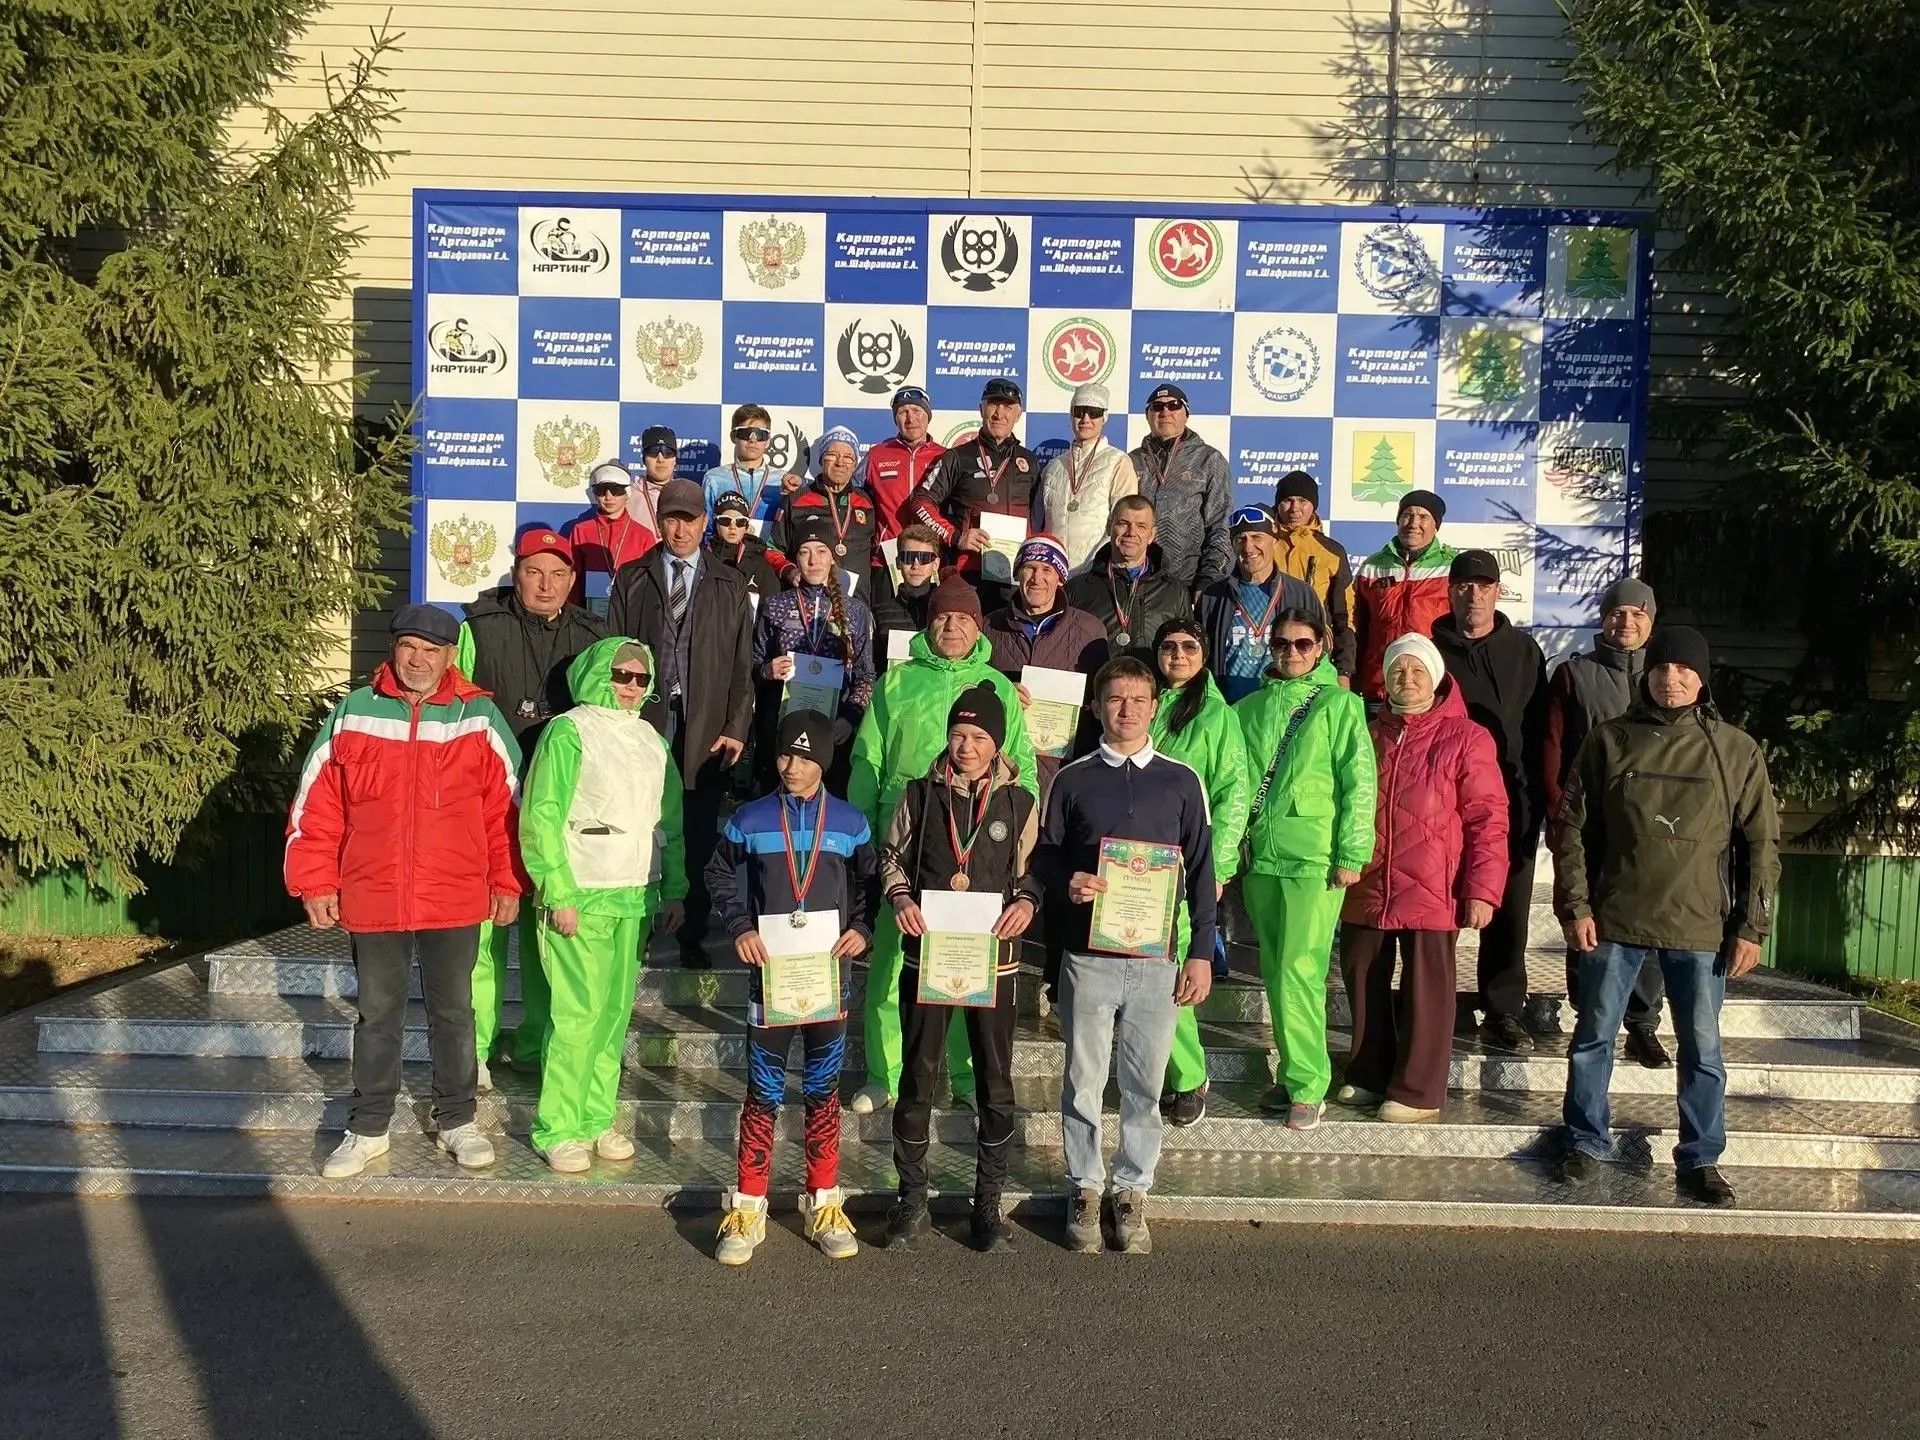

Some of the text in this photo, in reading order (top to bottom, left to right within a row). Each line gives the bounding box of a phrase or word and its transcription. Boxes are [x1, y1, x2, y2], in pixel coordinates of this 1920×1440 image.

[428, 224, 505, 236] Картодром
[631, 228, 710, 240] Картодром
[430, 237, 502, 248] "Аргамак"
[836, 233, 915, 245] Картодром
[1042, 237, 1121, 249] Картодром
[634, 242, 706, 253] "Аргамак"
[839, 246, 912, 258] "Аргамак"
[1248, 241, 1327, 253] Картодром
[629, 256, 696, 266] им.Шафранова
[1045, 250, 1118, 262] "Аргамак"
[1251, 254, 1324, 266] "Аргамак"
[533, 264, 591, 273] КАРТИНГ
[834, 260, 900, 270] им.Шафранова
[1040, 264, 1106, 274] им.Шафранова
[1246, 268, 1312, 279] им.Шафранова
[533, 330, 612, 342] Картодром
[735, 335, 814, 347] Картодром
[536, 343, 609, 354] "Аргамак"
[937, 339, 1016, 351] Картодром
[1142, 344, 1221, 356] Картодром
[738, 348, 810, 360] "Аргамак"
[940, 352, 1012, 364] "Аргамак"
[1348, 348, 1427, 360] Картодром
[531, 357, 598, 367] им.Шафранова
[733, 362, 800, 372] им.Шафранова
[1145, 357, 1217, 368] "Аргамак"
[1351, 361, 1423, 372] "Аргамак"
[431, 364, 488, 374] КАРТИНГ
[935, 366, 1001, 377] им.Шафранова
[1140, 371, 1206, 381] им.Шафранова
[1346, 375, 1412, 385] им.Шафранова
[427, 430, 504, 442] Картодром
[430, 443, 501, 454] "Аргамак"
[1240, 450, 1319, 462] Картодром
[1446, 450, 1525, 462] Картодром
[1243, 462, 1315, 474] "Аргамак"
[1449, 463, 1521, 474] "Аргамак"
[1444, 477, 1510, 487] им.Шафранова
